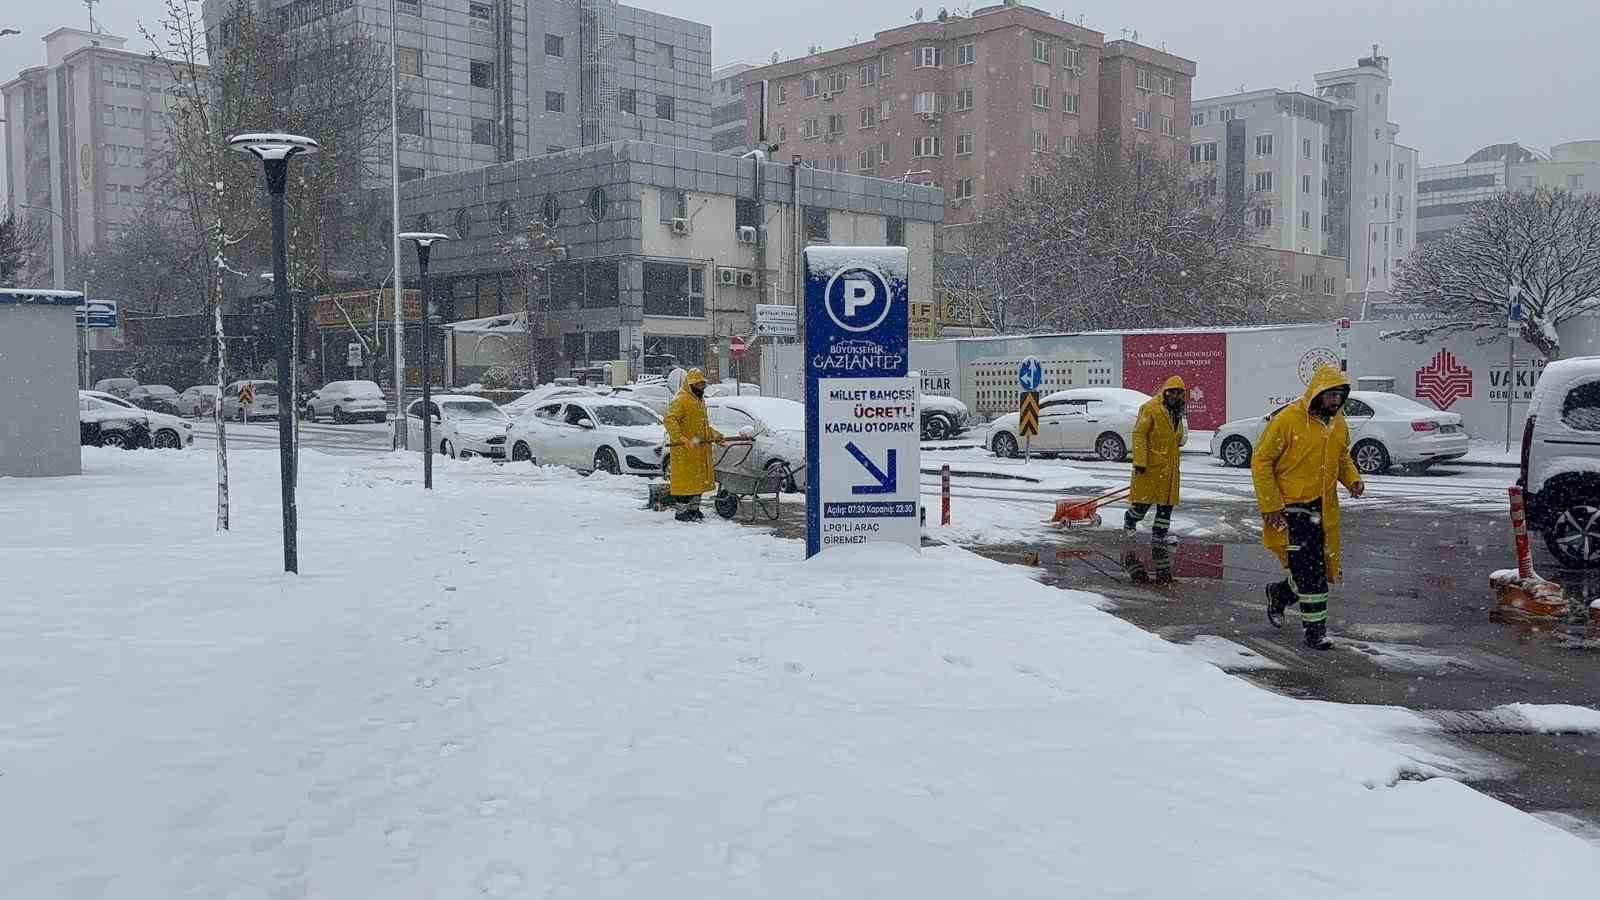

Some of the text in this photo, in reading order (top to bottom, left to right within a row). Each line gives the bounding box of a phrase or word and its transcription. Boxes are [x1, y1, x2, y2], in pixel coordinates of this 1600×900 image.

[844, 279, 876, 316] P
[920, 378, 951, 391] IFLAR
[830, 389, 868, 401] MİLLET
[869, 387, 915, 402] BAHÇESİ
[1490, 390, 1519, 399] GENL
[854, 403, 915, 419] ÜCRETLİ
[825, 421, 914, 434] KAPALI OTOPARK
[848, 504, 866, 513] 07:30
[895, 503, 913, 513] 23:30
[854, 522, 880, 533] ARAÇ
